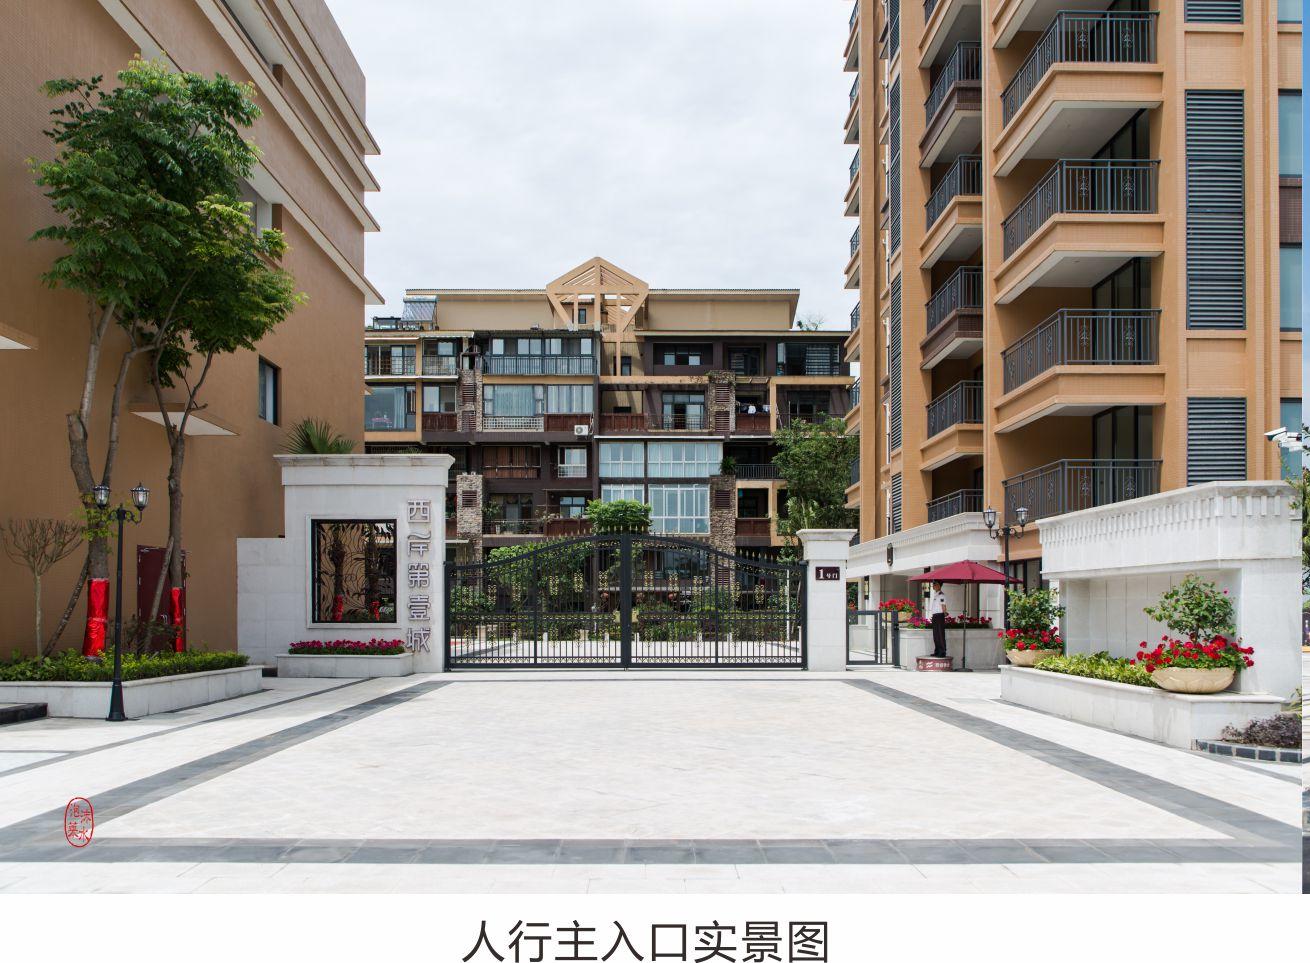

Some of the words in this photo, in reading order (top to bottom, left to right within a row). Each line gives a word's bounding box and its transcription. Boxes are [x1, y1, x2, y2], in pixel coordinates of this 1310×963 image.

[407, 500, 431, 652] 西岸第壹城
